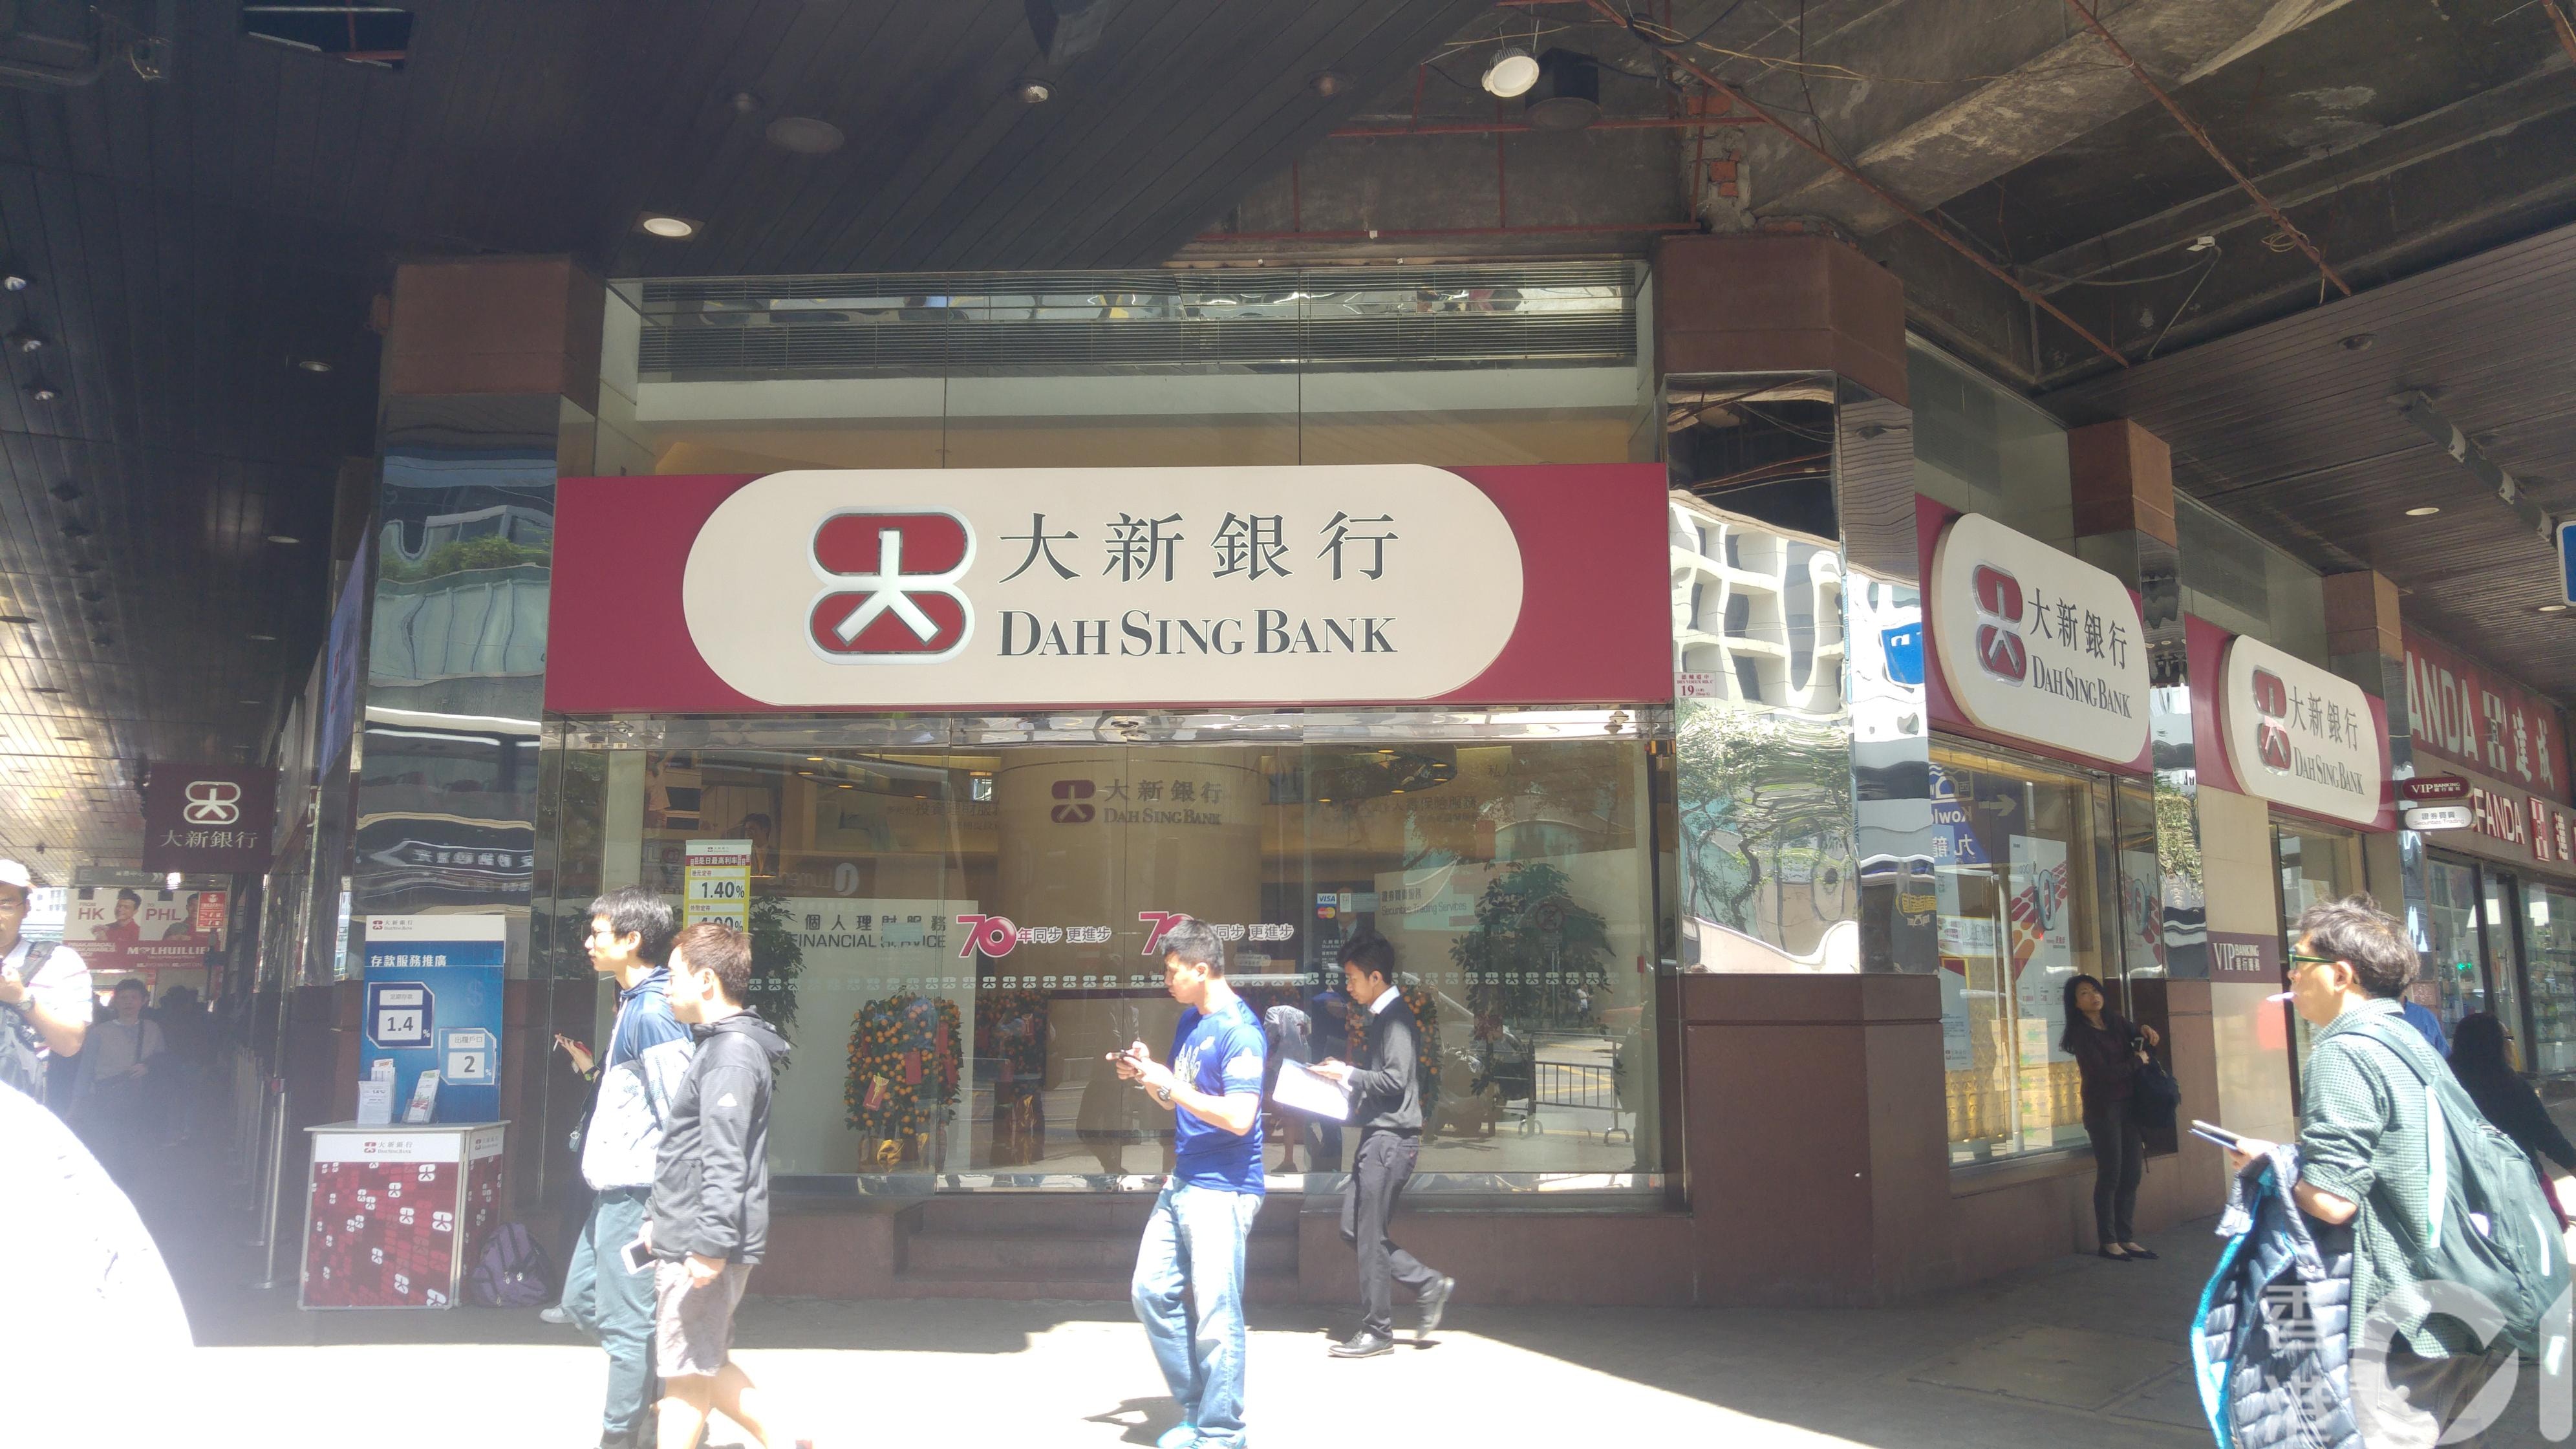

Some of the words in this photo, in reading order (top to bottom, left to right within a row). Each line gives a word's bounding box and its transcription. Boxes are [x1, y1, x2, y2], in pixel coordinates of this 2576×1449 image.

[998, 511, 1399, 583] 大新銀行
[996, 610, 1111, 656] DAH
[1120, 609, 1246, 657] SING
[1253, 608, 1398, 654] BANK
[2027, 587, 2128, 671] 大新銀行
[1681, 685, 1694, 696] 19
[2031, 654, 2065, 694] DAH
[2065, 668, 2099, 709] SING
[2098, 682, 2132, 719] BANK
[2288, 685, 2358, 751] 大新銀行
[2293, 746, 2316, 780] DAH
[2316, 755, 2340, 788] SING
[2339, 762, 2365, 797] BANK
[1103, 778, 1223, 804] 大新銀行
[2411, 784, 2433, 794] VIP
[1103, 807, 1141, 824] DAH
[1143, 806, 1182, 824] SING
[1183, 808, 1222, 826] BANK
[2473, 787, 2526, 844] FANDA
[160, 830, 259, 849] 大新銀行
[78, 907, 105, 921] HK
[145, 908, 182, 921] PHL
[1438, 901, 1467, 912] Services
[880, 934, 947, 948] SICE
[1066, 925, 1111, 944] 更進步
[1249, 923, 1295, 941] 更進步
[370, 954, 447, 967] 存款服務推廣
[2213, 943, 2235, 970] VIP
[2235, 944, 2260, 957] BANKING
[387, 1016, 414, 1033] 1.4
[464, 1055, 475, 1073] 2
